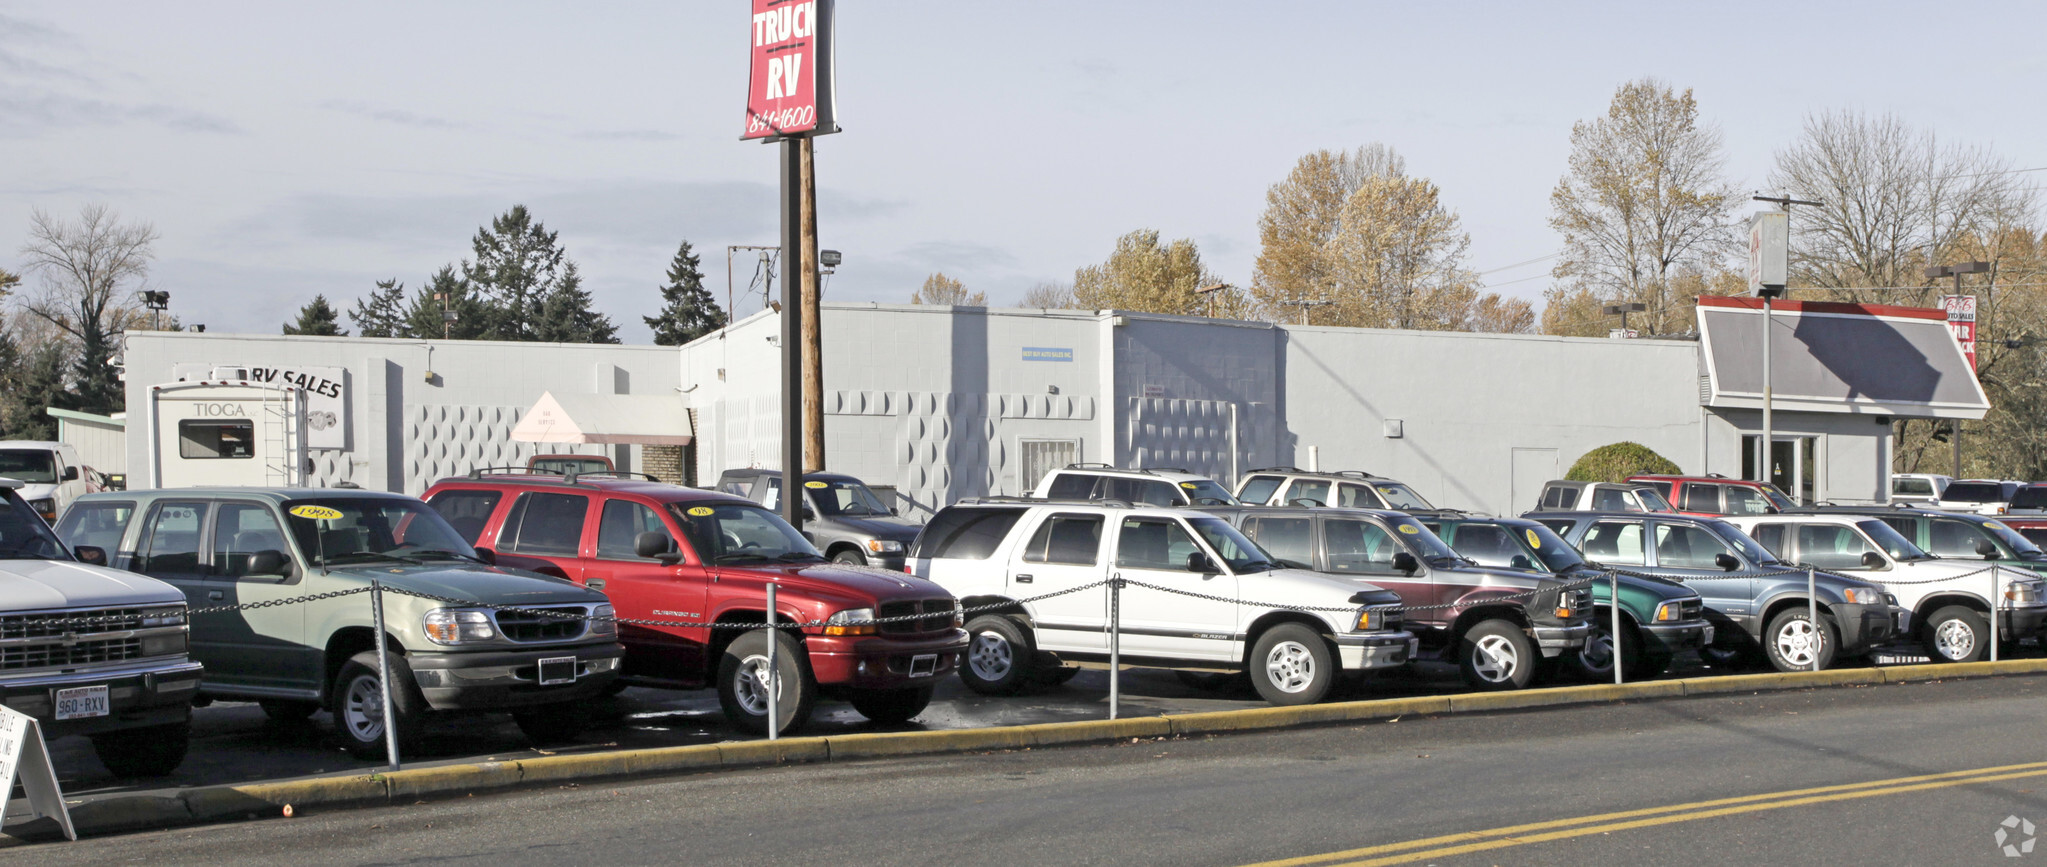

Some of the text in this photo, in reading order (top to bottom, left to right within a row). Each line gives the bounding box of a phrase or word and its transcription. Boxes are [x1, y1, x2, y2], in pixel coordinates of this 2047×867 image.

[753, 1, 816, 47] TRUCK
[766, 53, 802, 100] RV
[749, 105, 814, 133] 841-1600
[252, 367, 342, 399] RV SALES
[193, 403, 246, 417] TIOGA
[299, 508, 335, 518] 1998
[694, 507, 708, 515] 98
